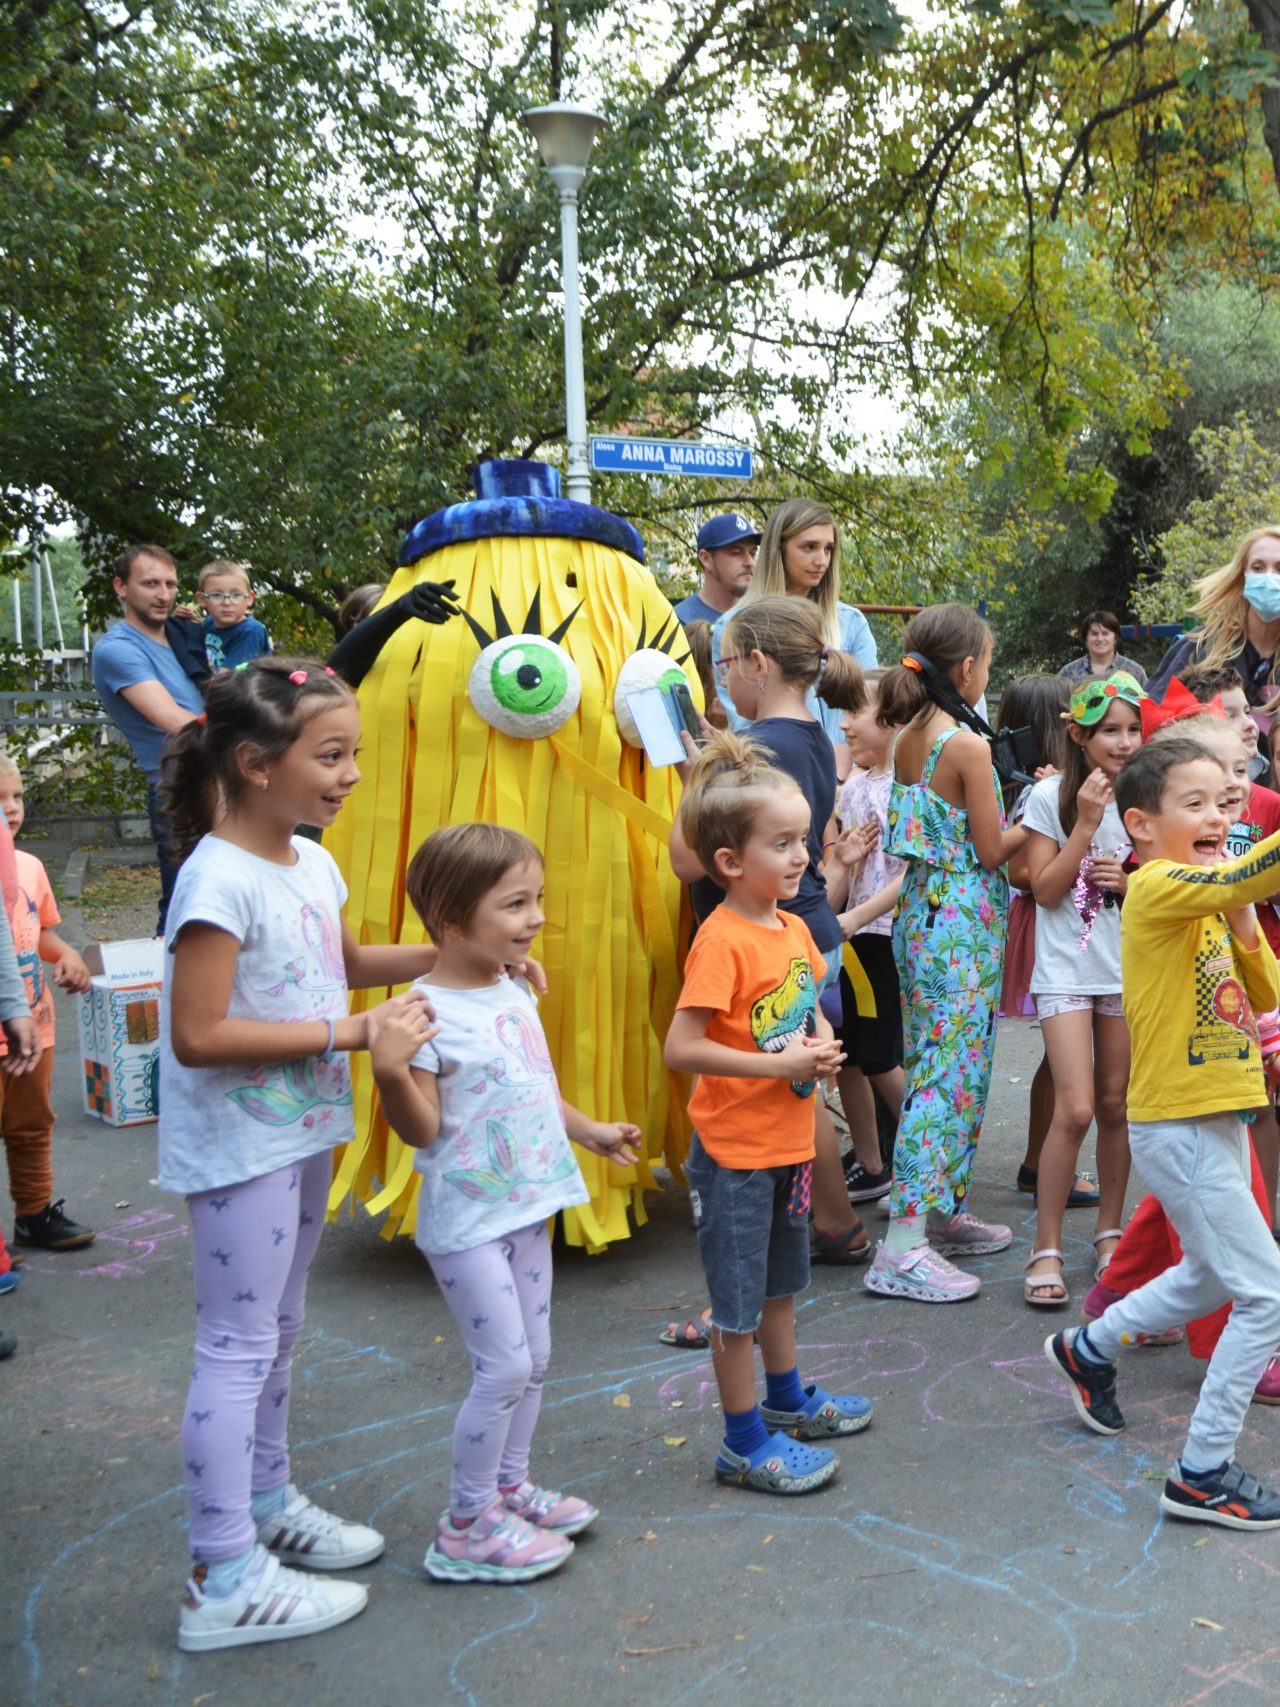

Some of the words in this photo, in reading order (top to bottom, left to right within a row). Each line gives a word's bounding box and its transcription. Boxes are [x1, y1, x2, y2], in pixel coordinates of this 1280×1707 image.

[621, 444, 665, 463] ANNA
[669, 447, 745, 468] MAROSSY
[139, 969, 154, 978] Italy
